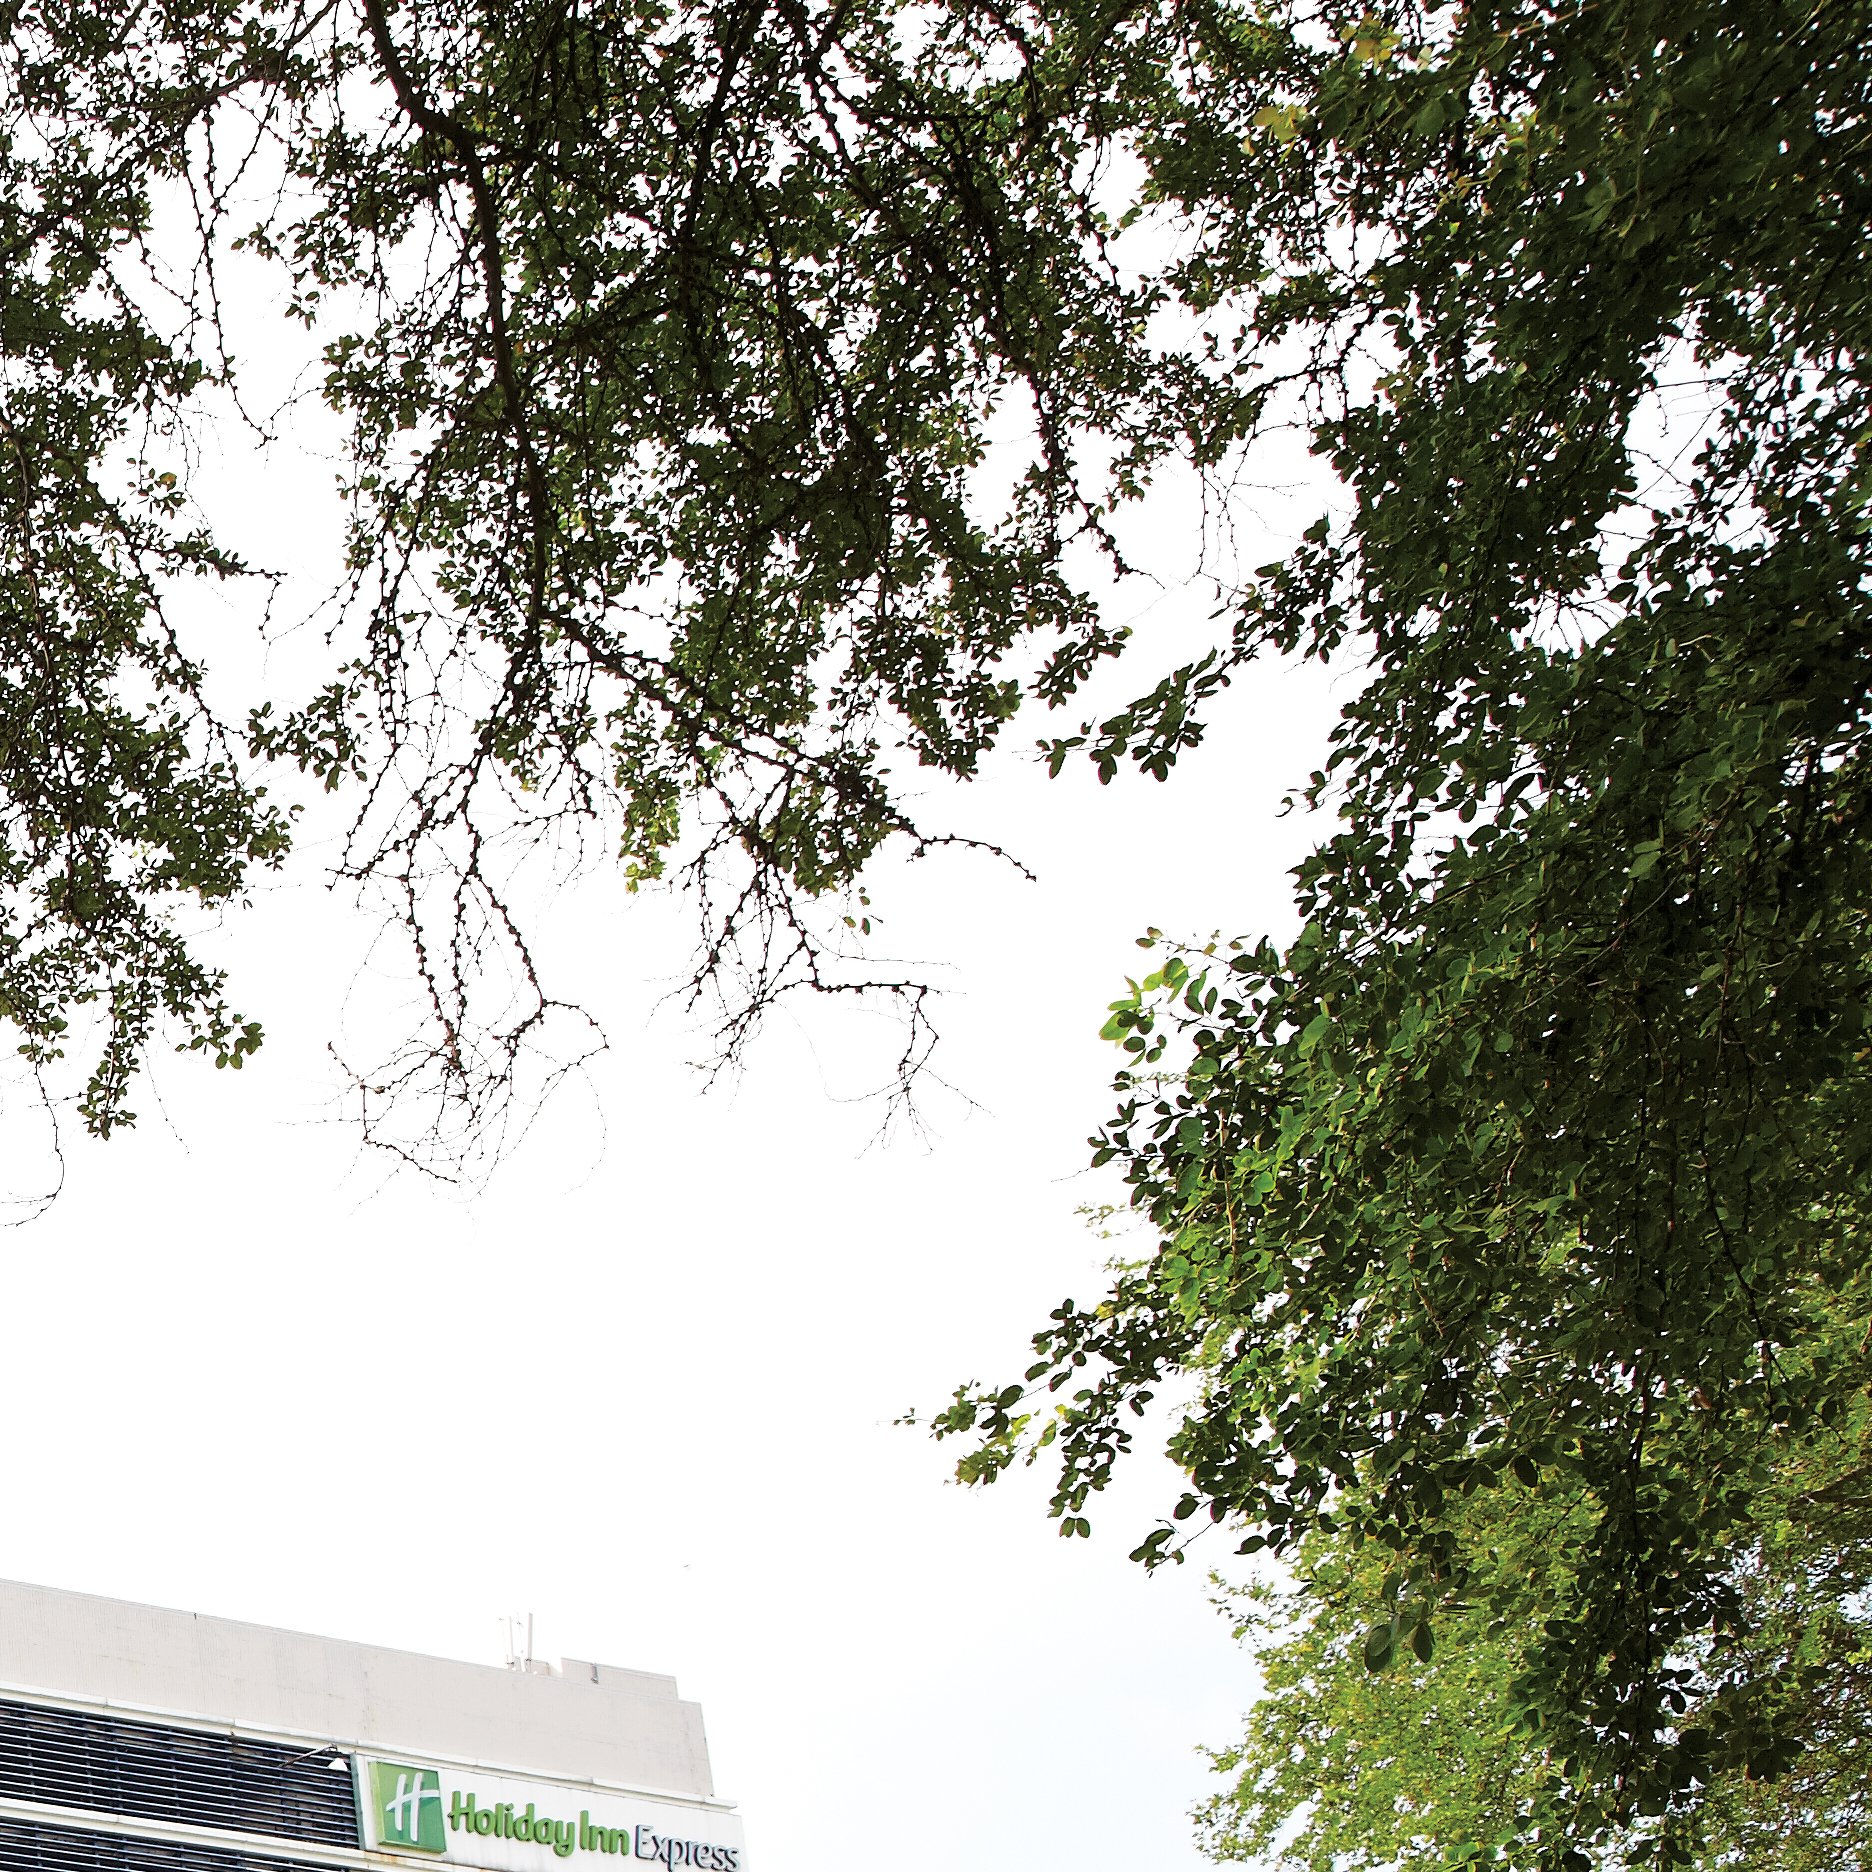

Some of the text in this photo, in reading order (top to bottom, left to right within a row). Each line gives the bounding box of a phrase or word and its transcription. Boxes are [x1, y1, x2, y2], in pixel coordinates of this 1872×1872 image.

[448, 1790, 741, 1872] Holiday Inn Express
